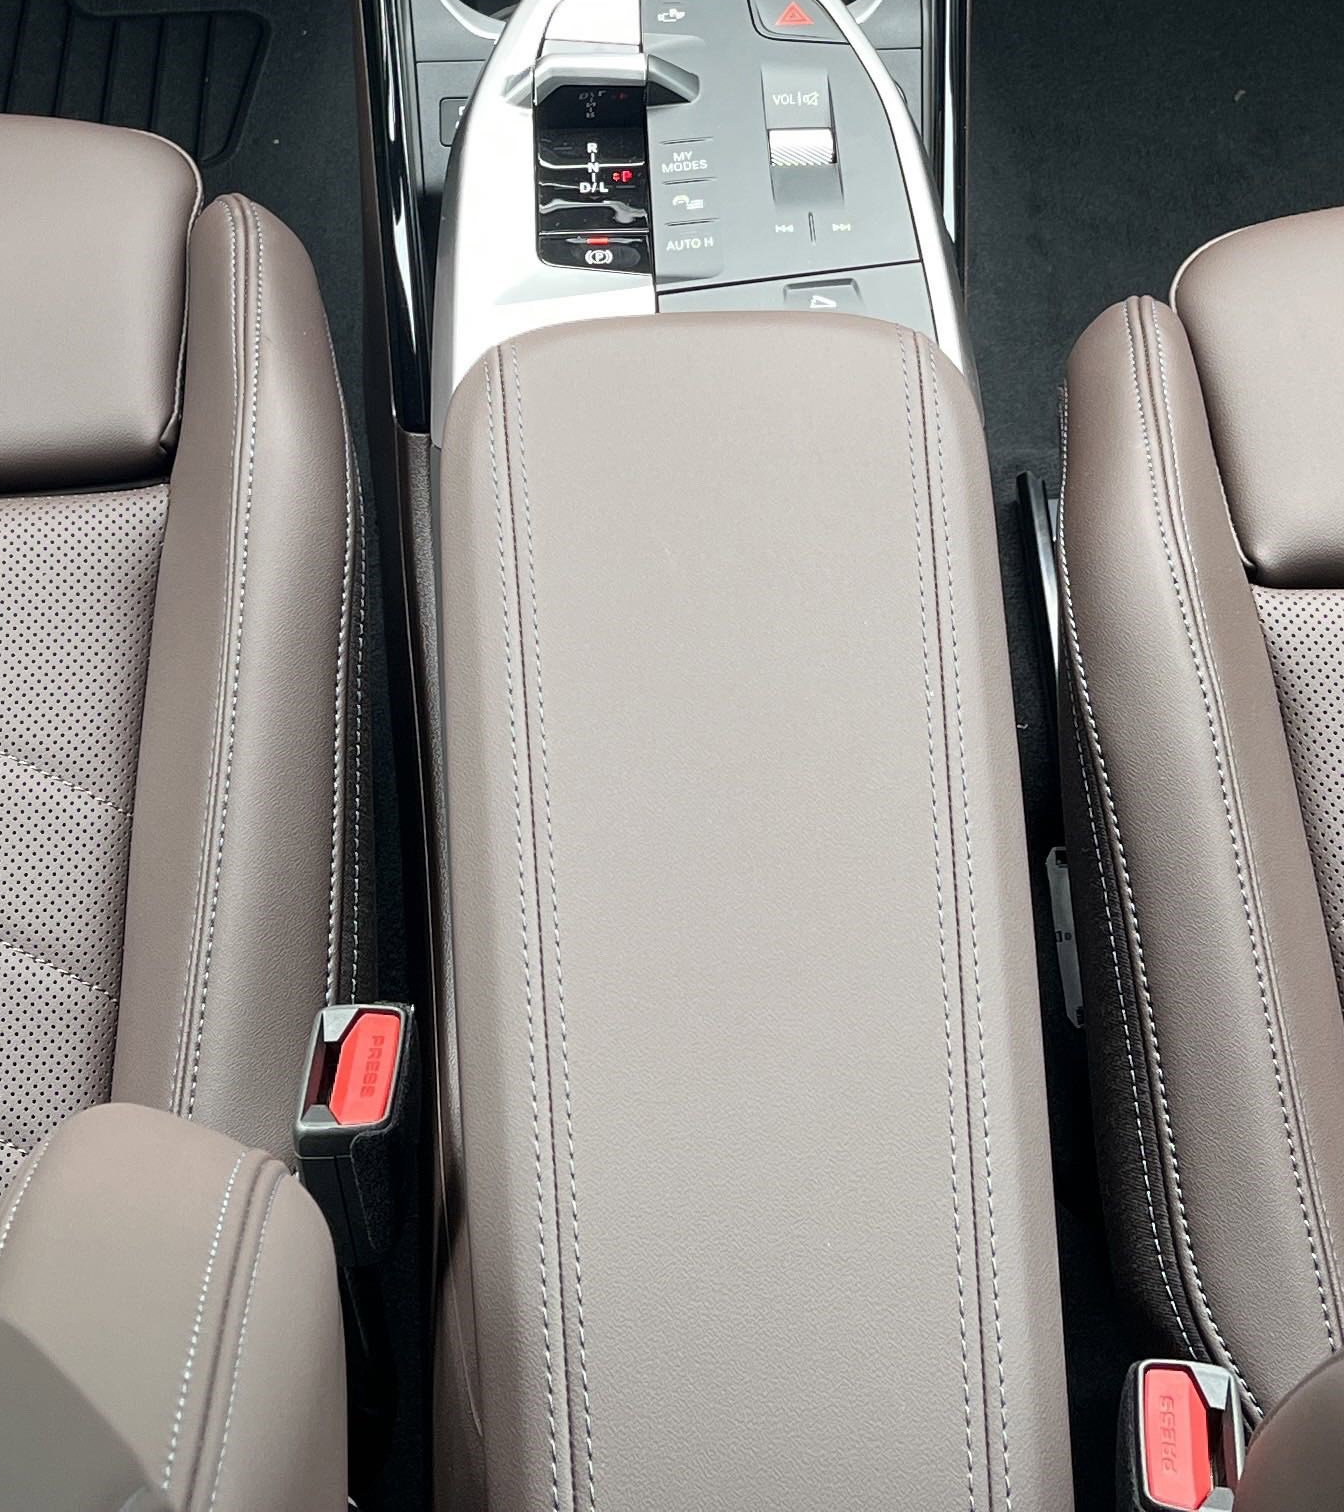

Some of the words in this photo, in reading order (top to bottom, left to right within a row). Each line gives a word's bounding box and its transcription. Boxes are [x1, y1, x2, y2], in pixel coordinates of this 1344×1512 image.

[772, 93, 796, 106] VOL
[673, 152, 693, 161] MY
[662, 160, 708, 173] MODES
[666, 238, 701, 251] AUTO
[704, 237, 714, 247] H
[359, 1035, 385, 1098] PRESS
[1160, 1395, 1177, 1472] PRESS
